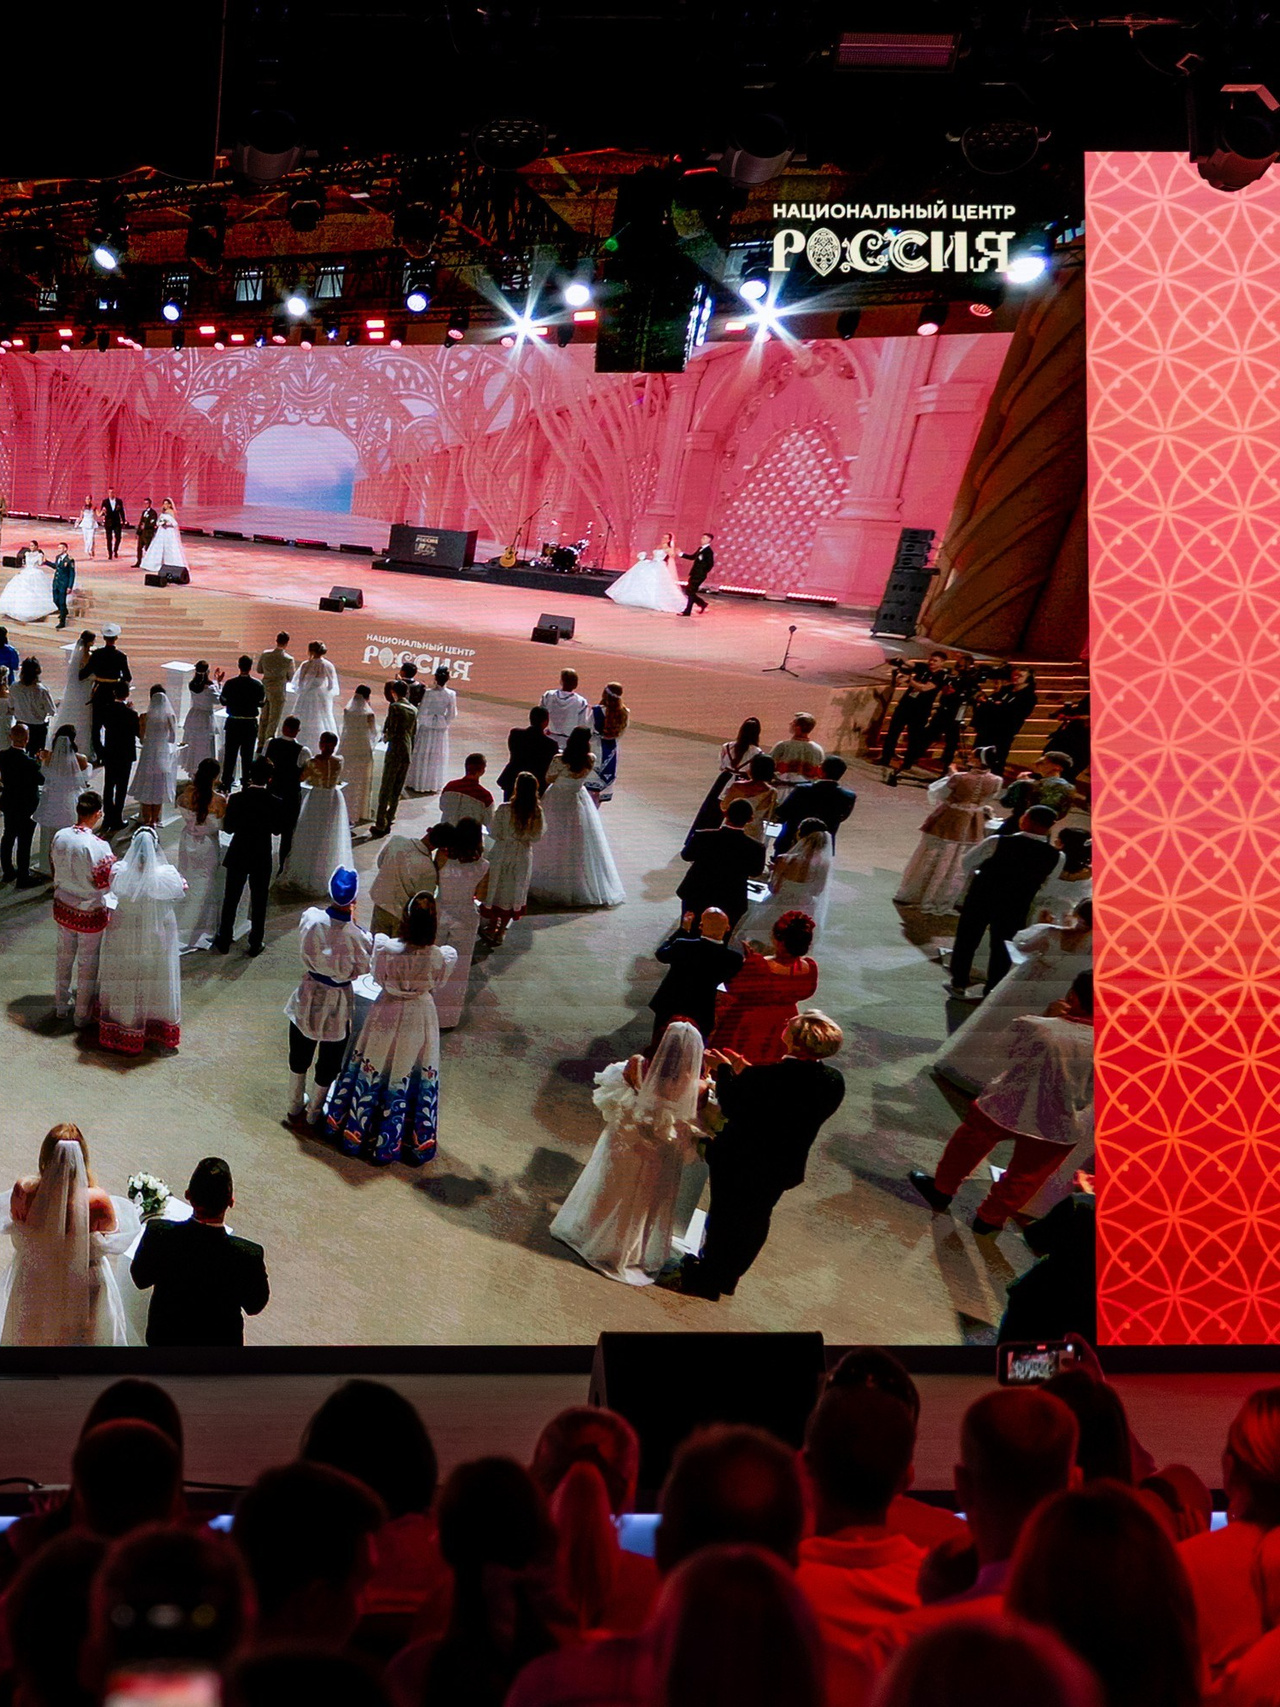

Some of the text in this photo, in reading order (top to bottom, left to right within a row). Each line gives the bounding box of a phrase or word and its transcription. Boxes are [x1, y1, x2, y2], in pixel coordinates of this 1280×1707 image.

[773, 200, 1016, 222] НАЦИОНАЛЬНЫЙ ЦЕНТР
[768, 227, 1017, 277] РОССИЯ
[366, 634, 476, 657] НАЦИОНАЛЬНЫЙ ЦЕНТР
